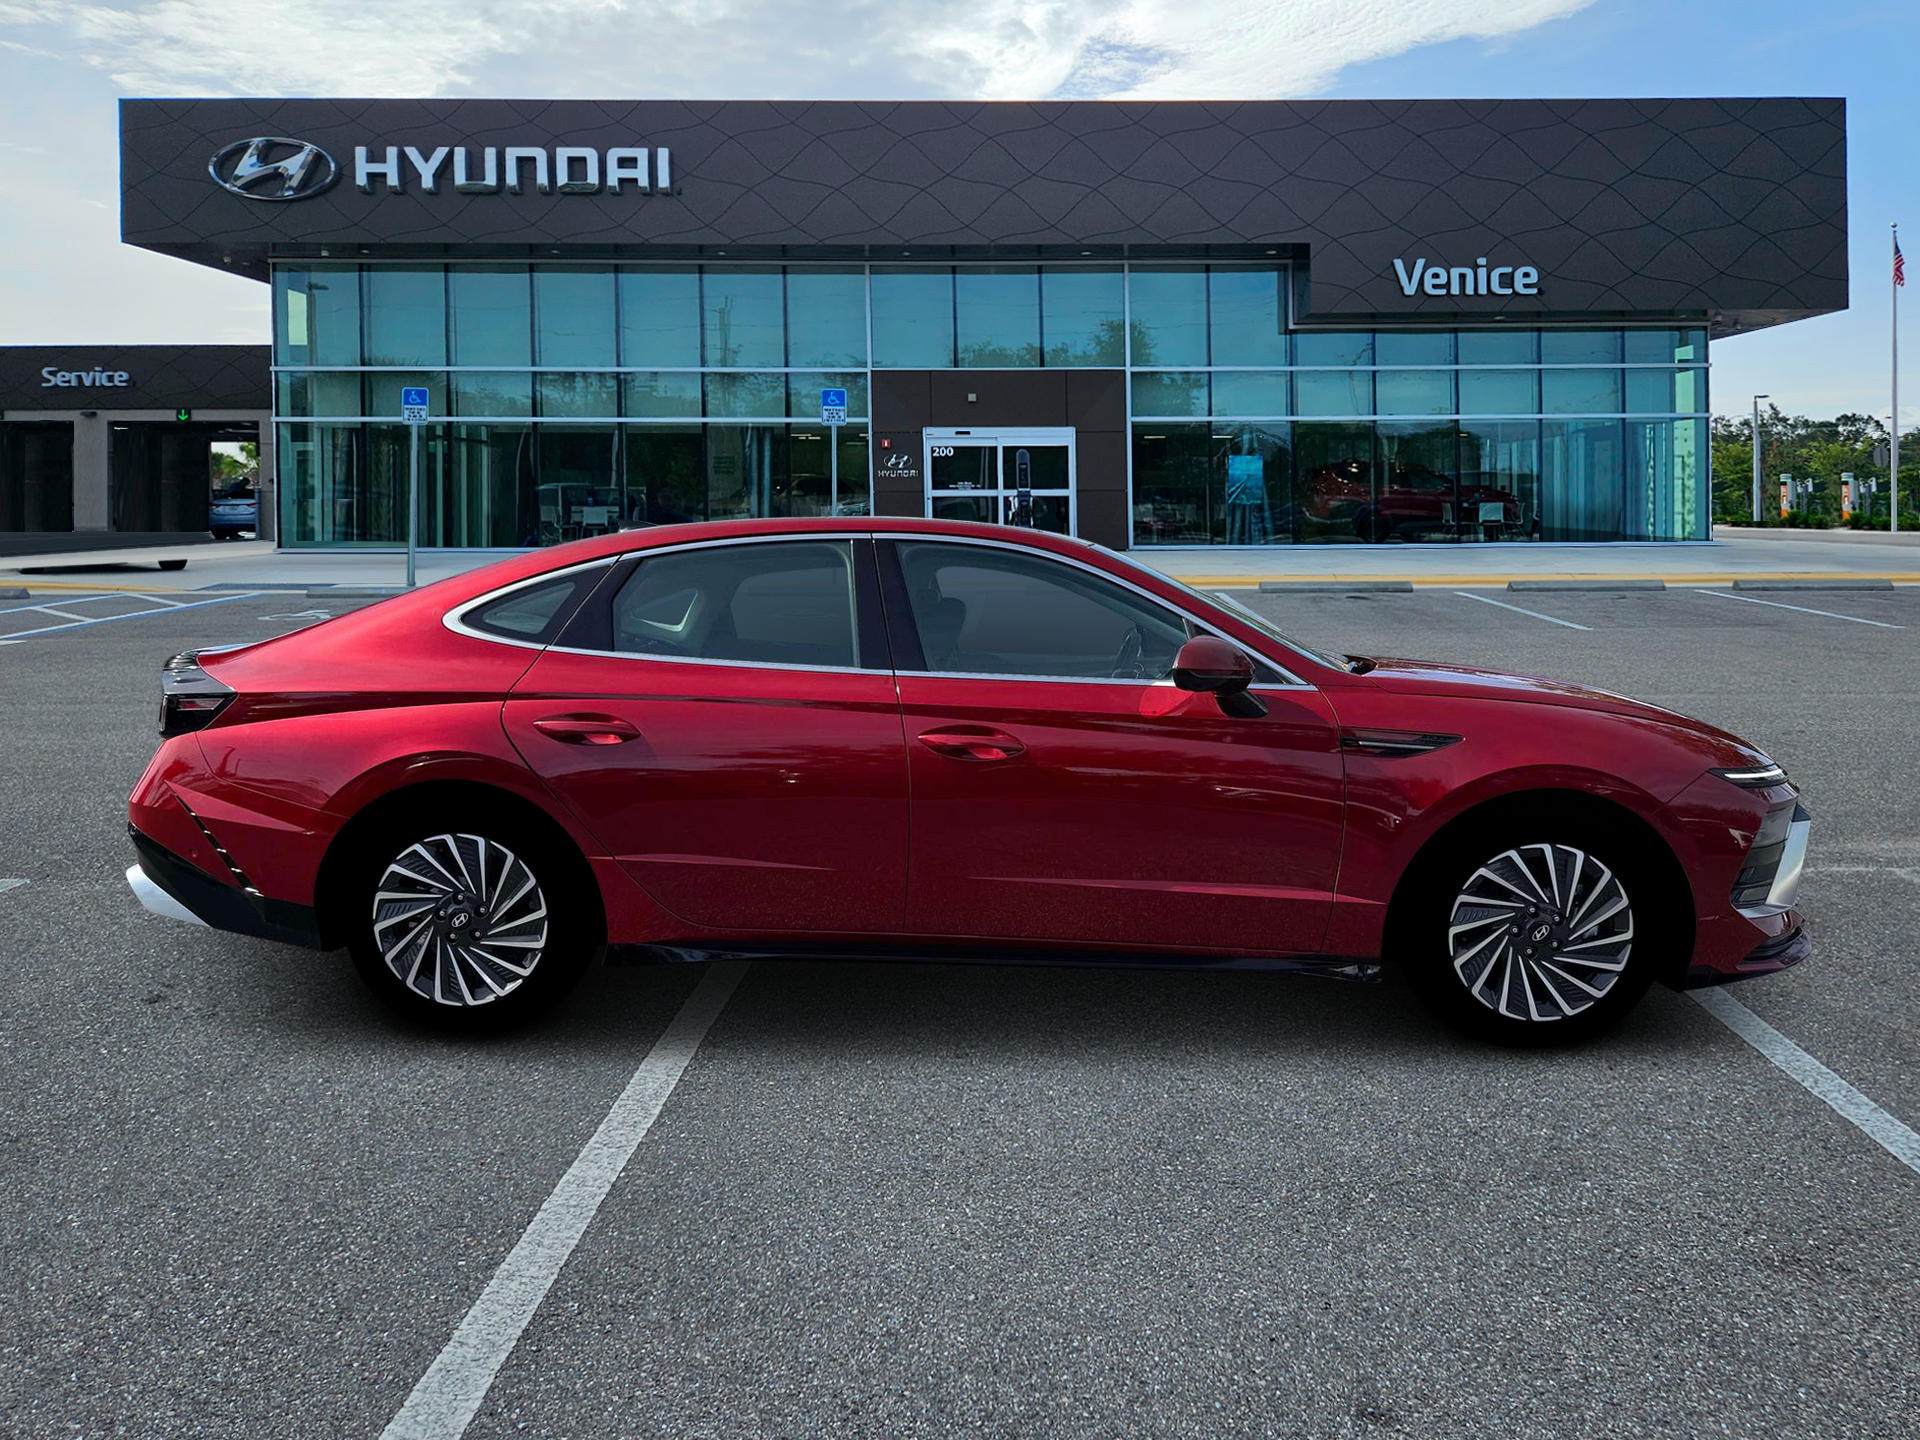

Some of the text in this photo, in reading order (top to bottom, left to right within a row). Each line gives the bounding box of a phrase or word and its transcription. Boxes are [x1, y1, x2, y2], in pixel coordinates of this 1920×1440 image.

[355, 146, 671, 194] HYUNDAI
[1393, 257, 1539, 296] Venice
[41, 366, 130, 388] Service
[932, 446, 954, 457] 200
[877, 470, 919, 478] HYUNDAI
